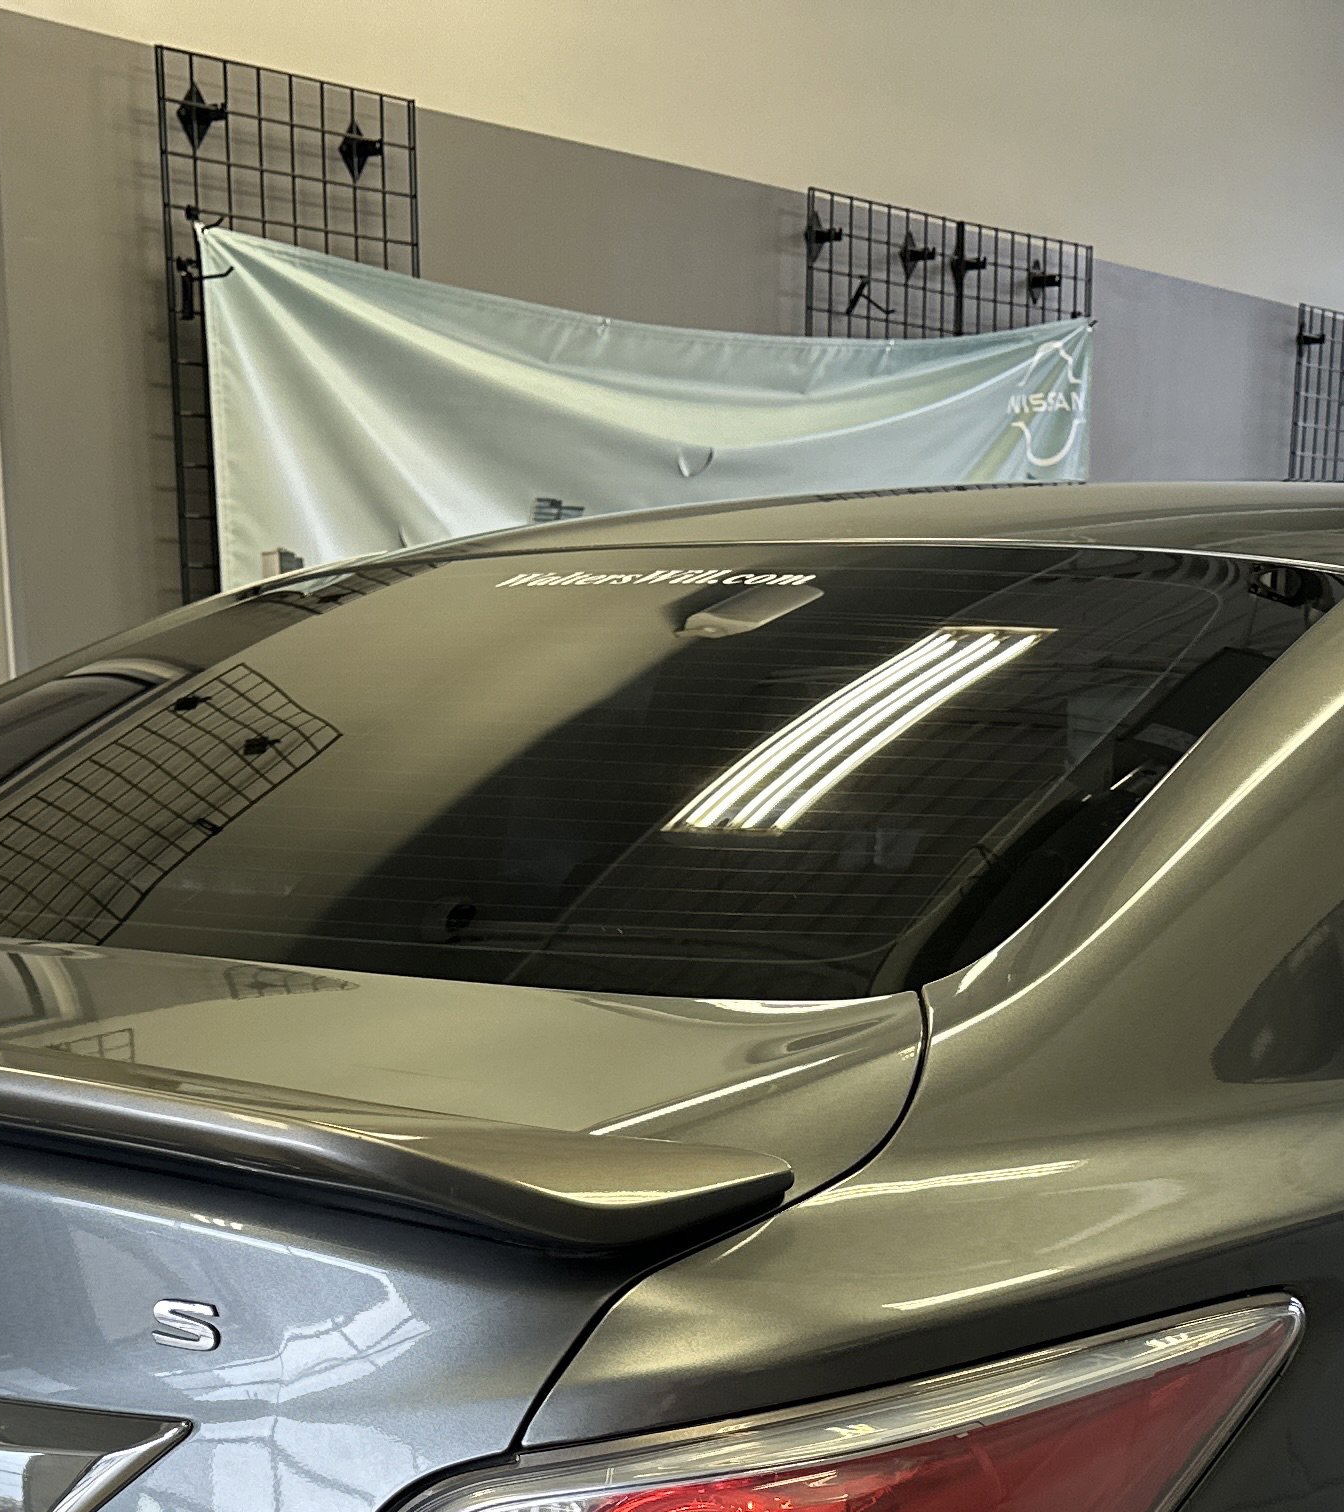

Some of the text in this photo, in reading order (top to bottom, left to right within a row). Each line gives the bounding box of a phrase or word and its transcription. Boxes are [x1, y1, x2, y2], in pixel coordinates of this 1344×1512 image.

[1007, 391, 1085, 414] NISSAN
[495, 569, 818, 588] WaltersWill.com
[152, 1299, 220, 1351] S
